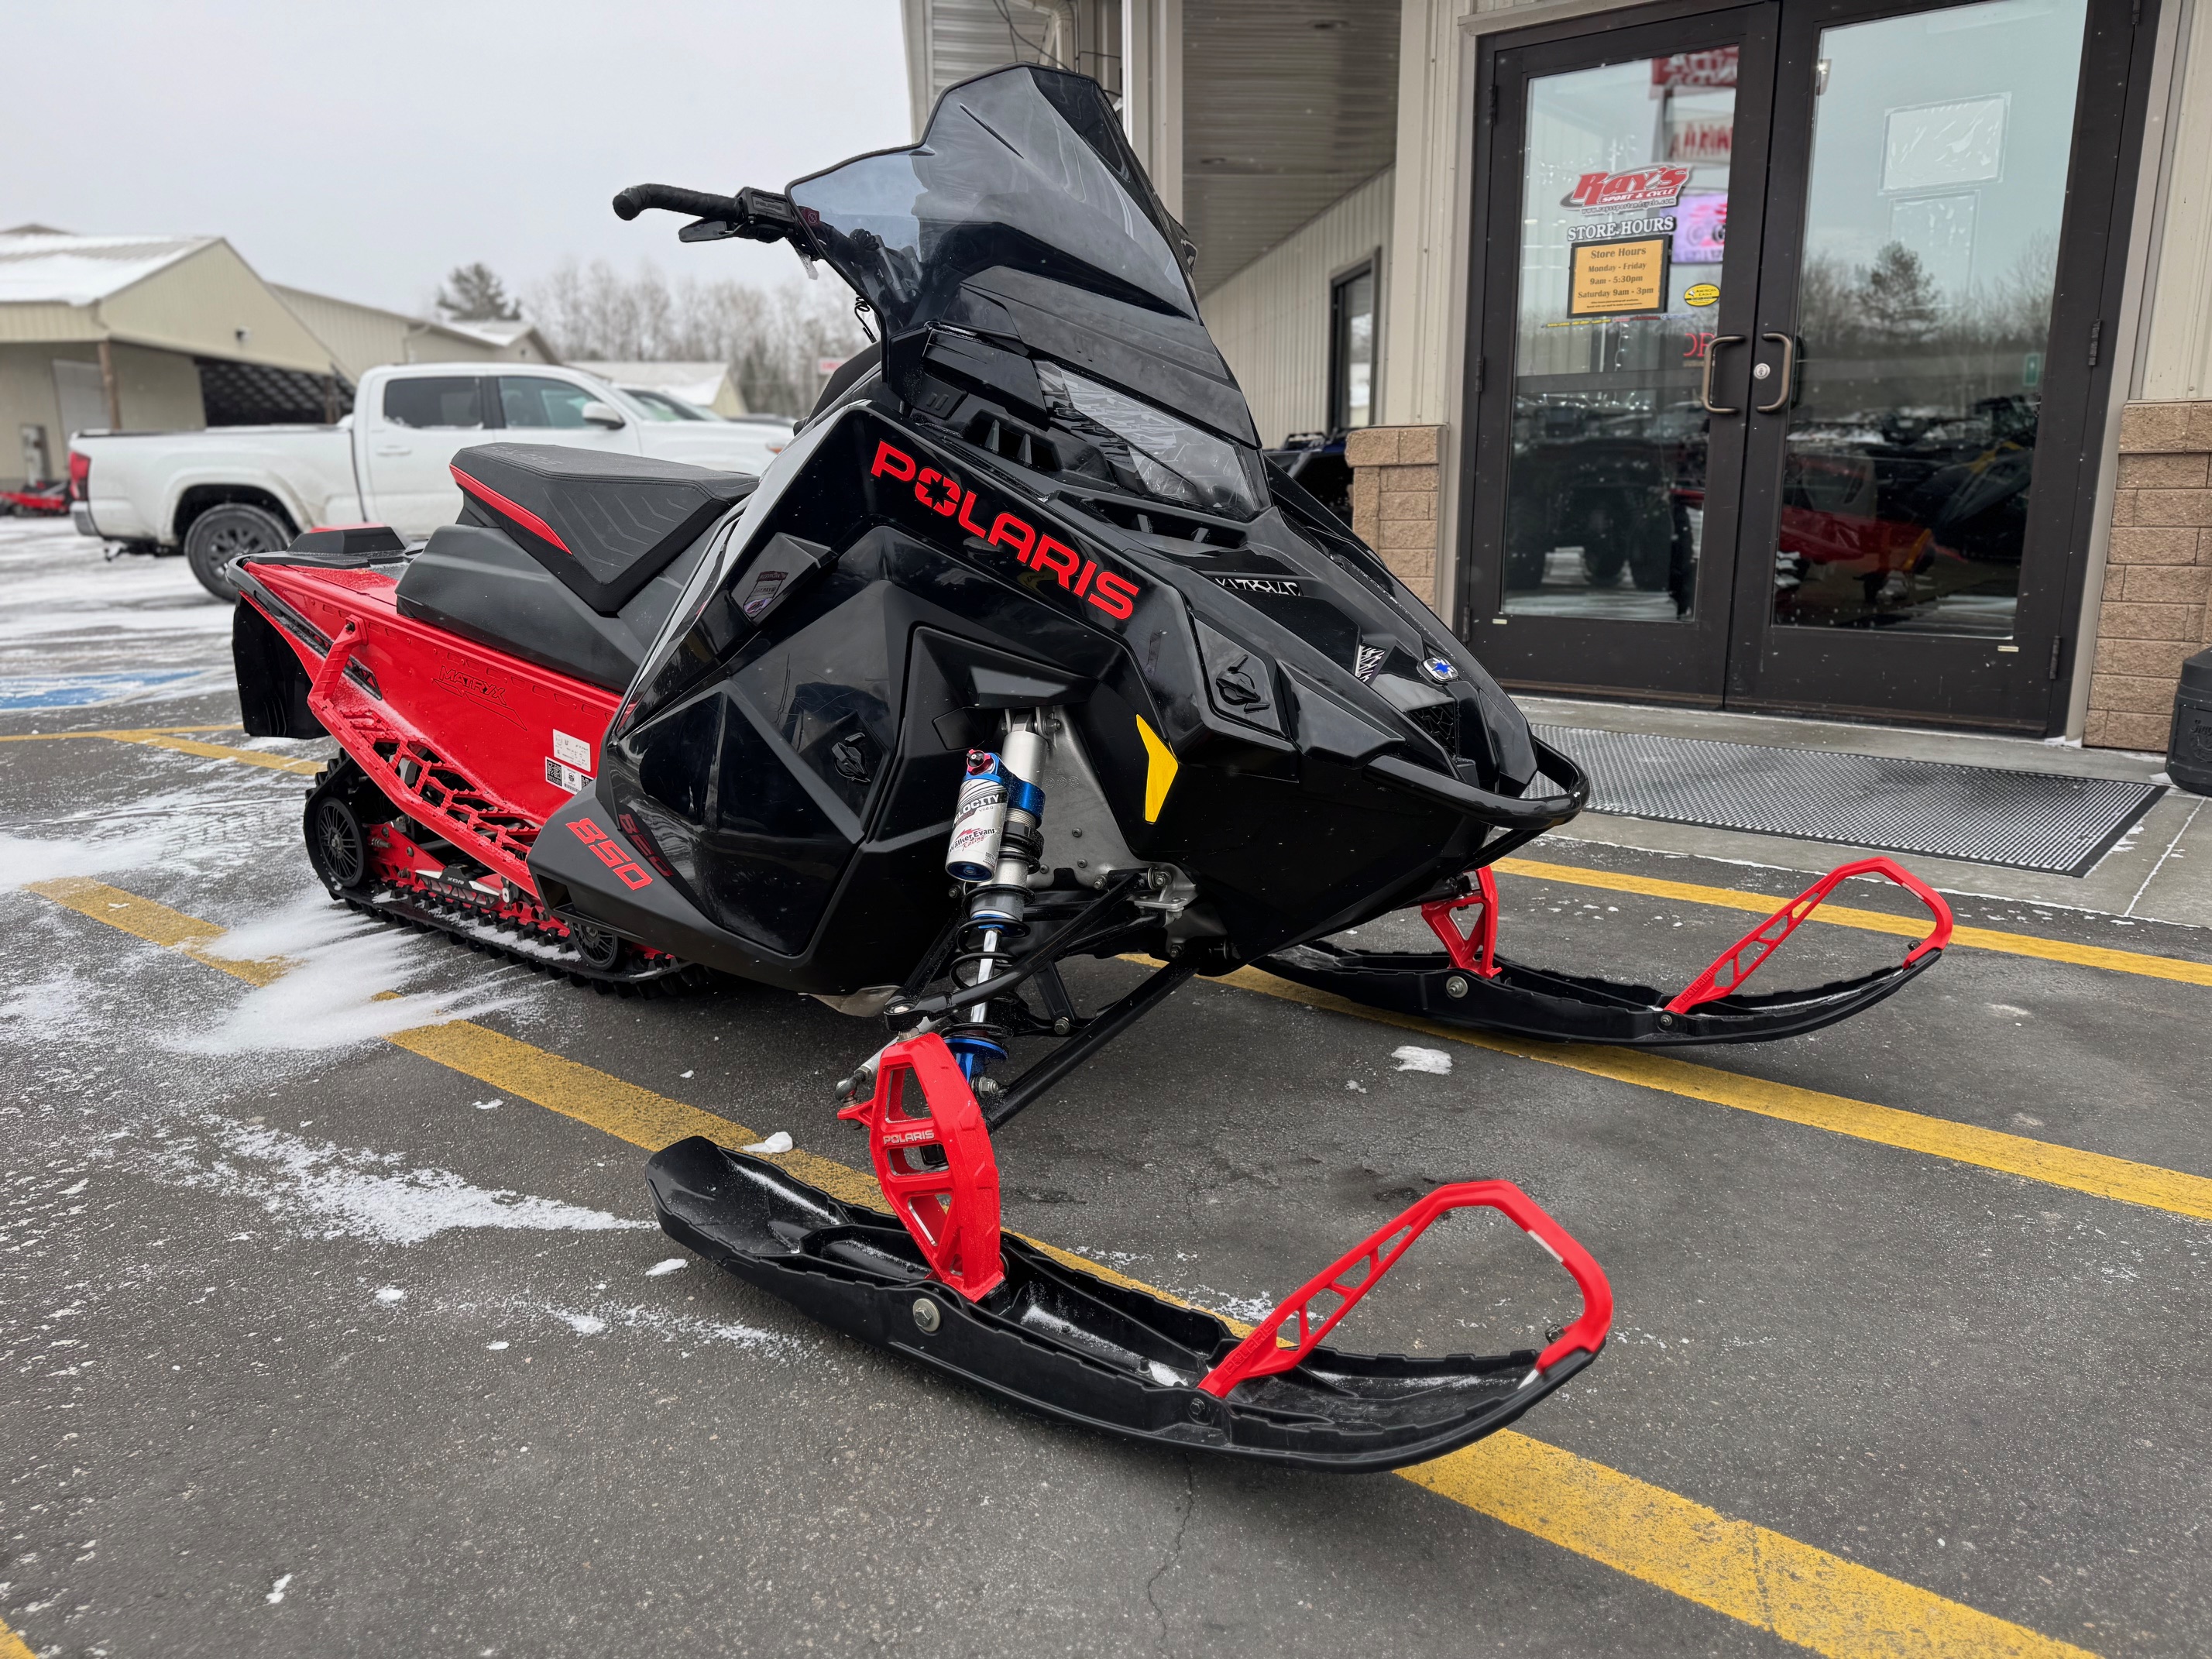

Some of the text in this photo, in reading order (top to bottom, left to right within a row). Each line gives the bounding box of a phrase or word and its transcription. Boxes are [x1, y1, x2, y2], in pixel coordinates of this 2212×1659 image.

[1602, 194, 1633, 203] SPORT
[1646, 188, 1675, 198] CYCLE
[1568, 216, 1674, 242] STORE HOURS
[1591, 248, 1647, 259] Store Hours
[1623, 262, 1647, 270] Friday
[1613, 275, 1644, 283] 5:30pm
[1578, 290, 1611, 299] Saturday
[1636, 287, 1654, 296] 3pm
[870, 440, 1140, 620] POLARIS
[438, 665, 507, 706] MATRYX
[949, 827, 996, 853] Walker Evans
[565, 817, 654, 891] 850
[1681, 966, 1719, 1003] POLARIS
[883, 1129, 935, 1146] POLARIS
[1224, 1320, 1276, 1376] POLARIS
